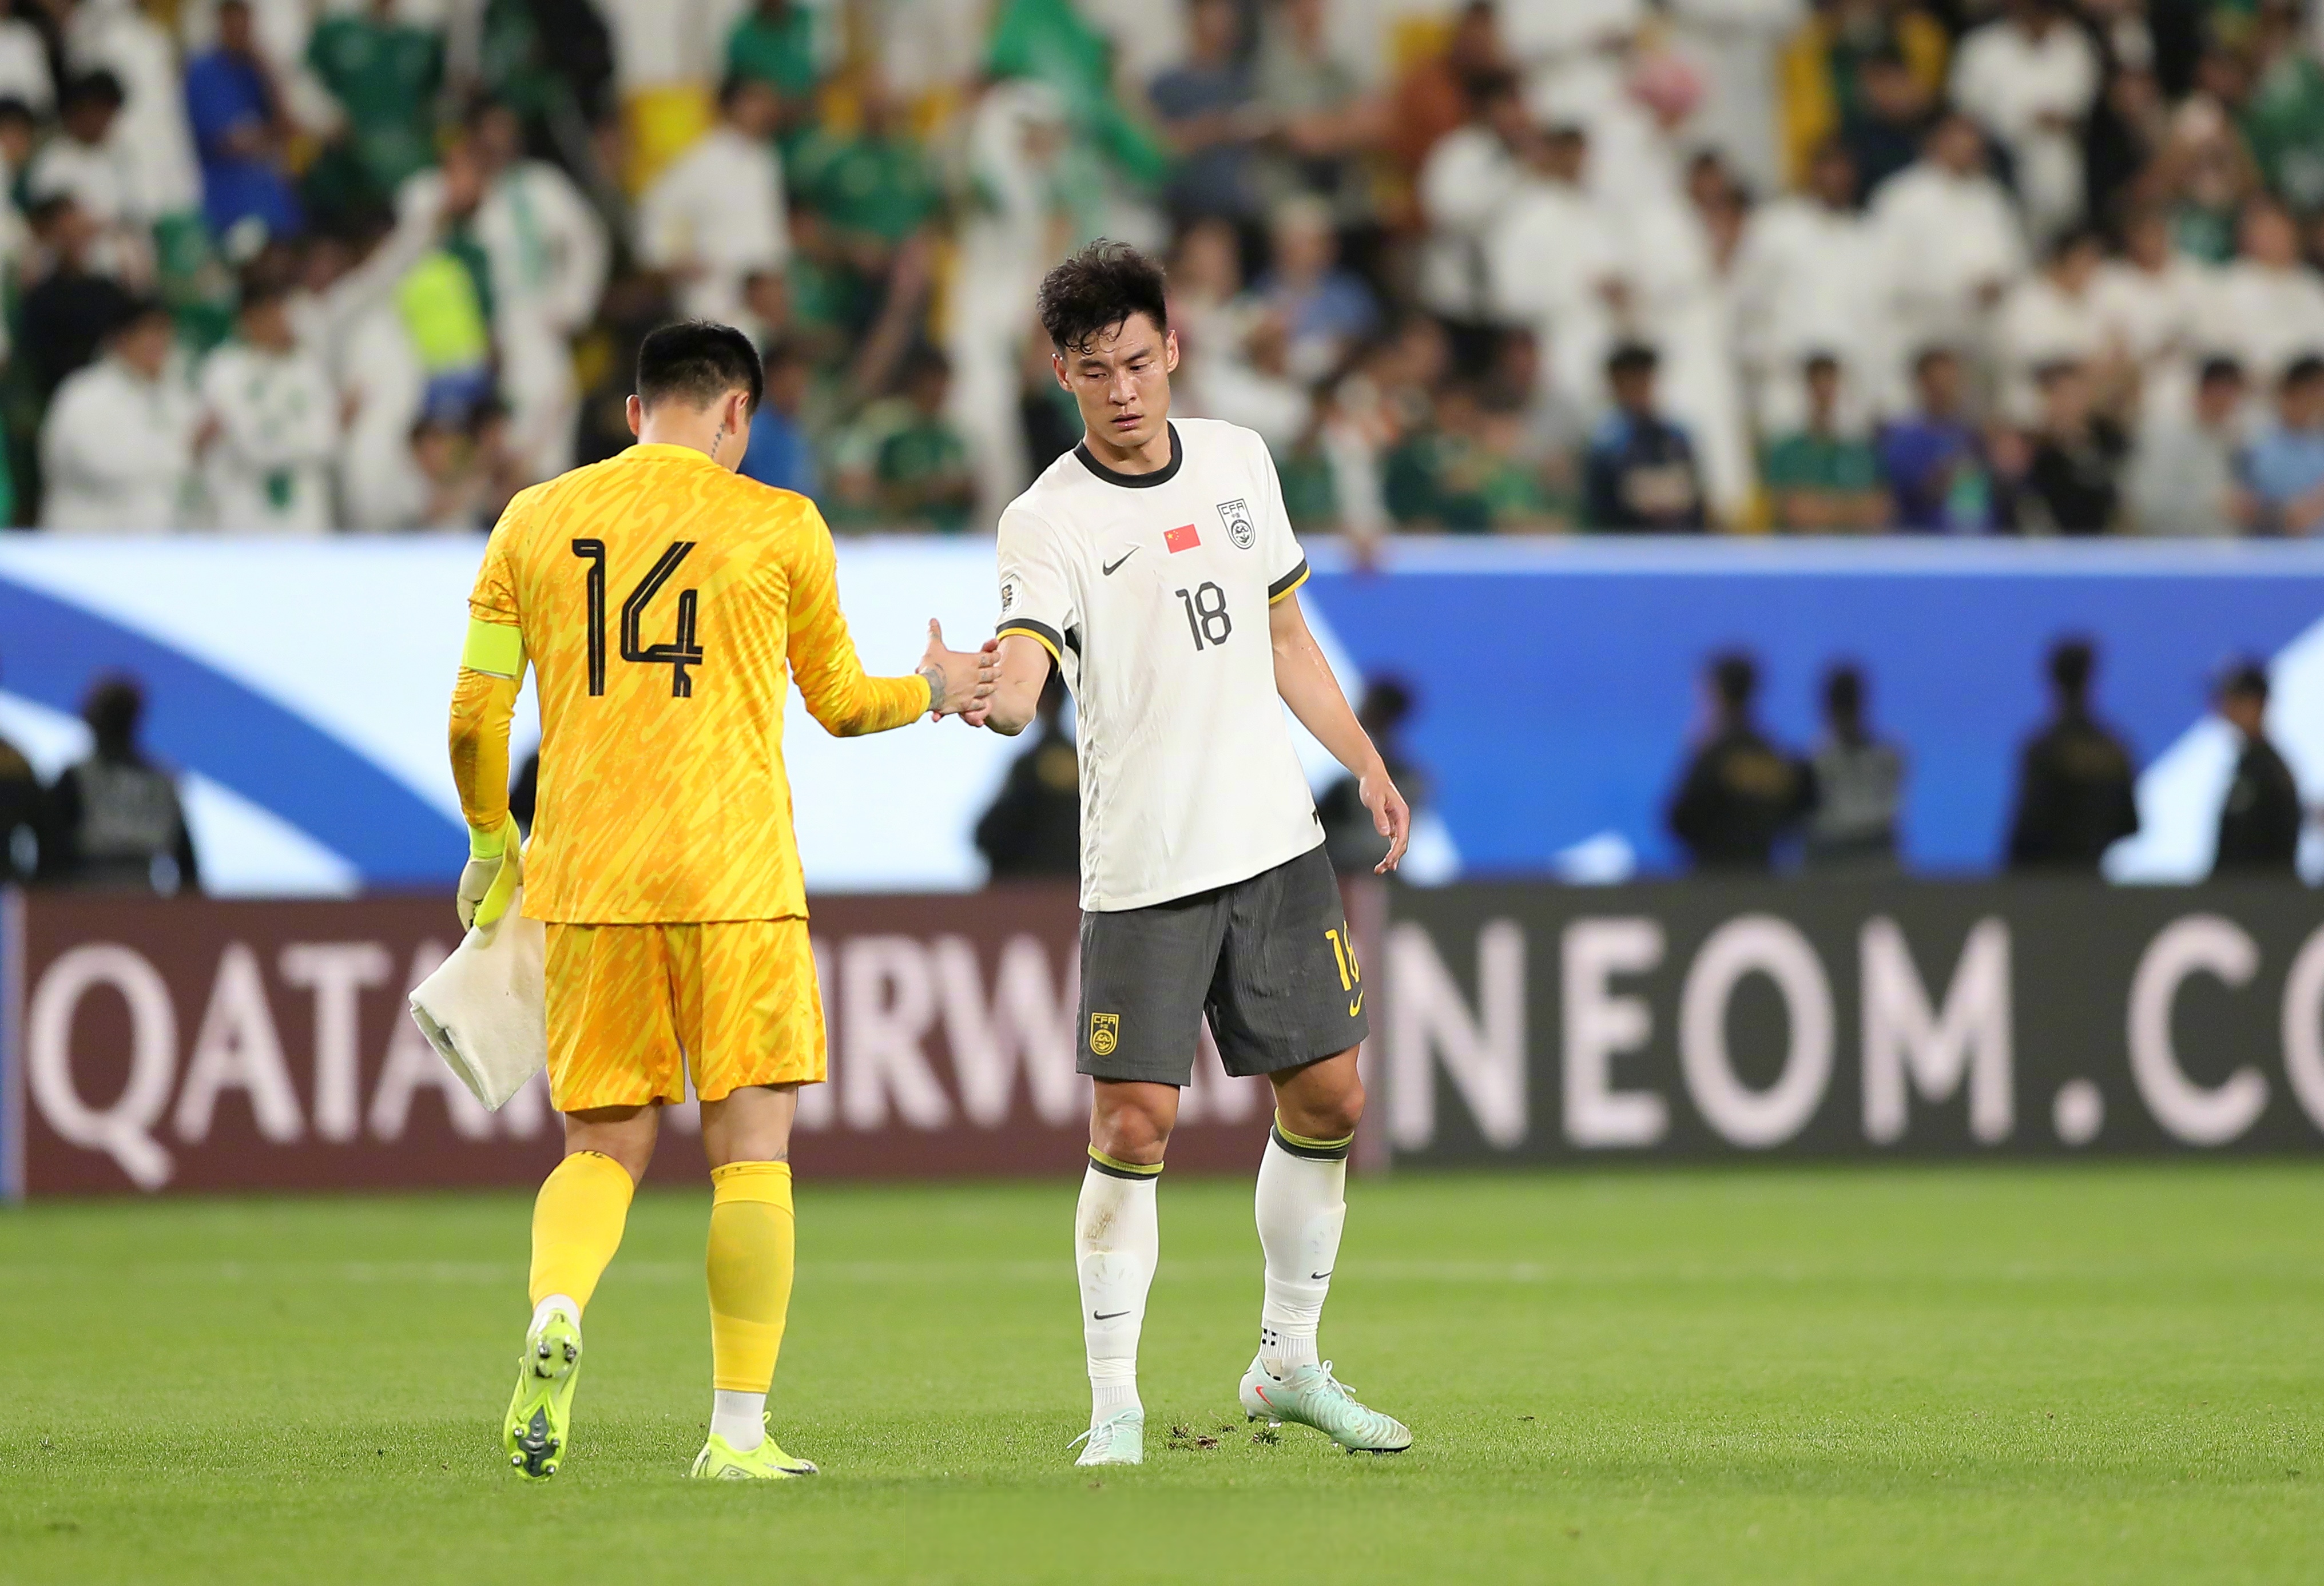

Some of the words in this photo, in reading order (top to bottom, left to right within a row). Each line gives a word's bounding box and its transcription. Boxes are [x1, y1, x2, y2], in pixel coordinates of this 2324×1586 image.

[1221, 502, 1245, 515] CFA
[572, 539, 703, 697] 14
[1175, 581, 1231, 651] 18
[1094, 1015, 1116, 1024] CFA
